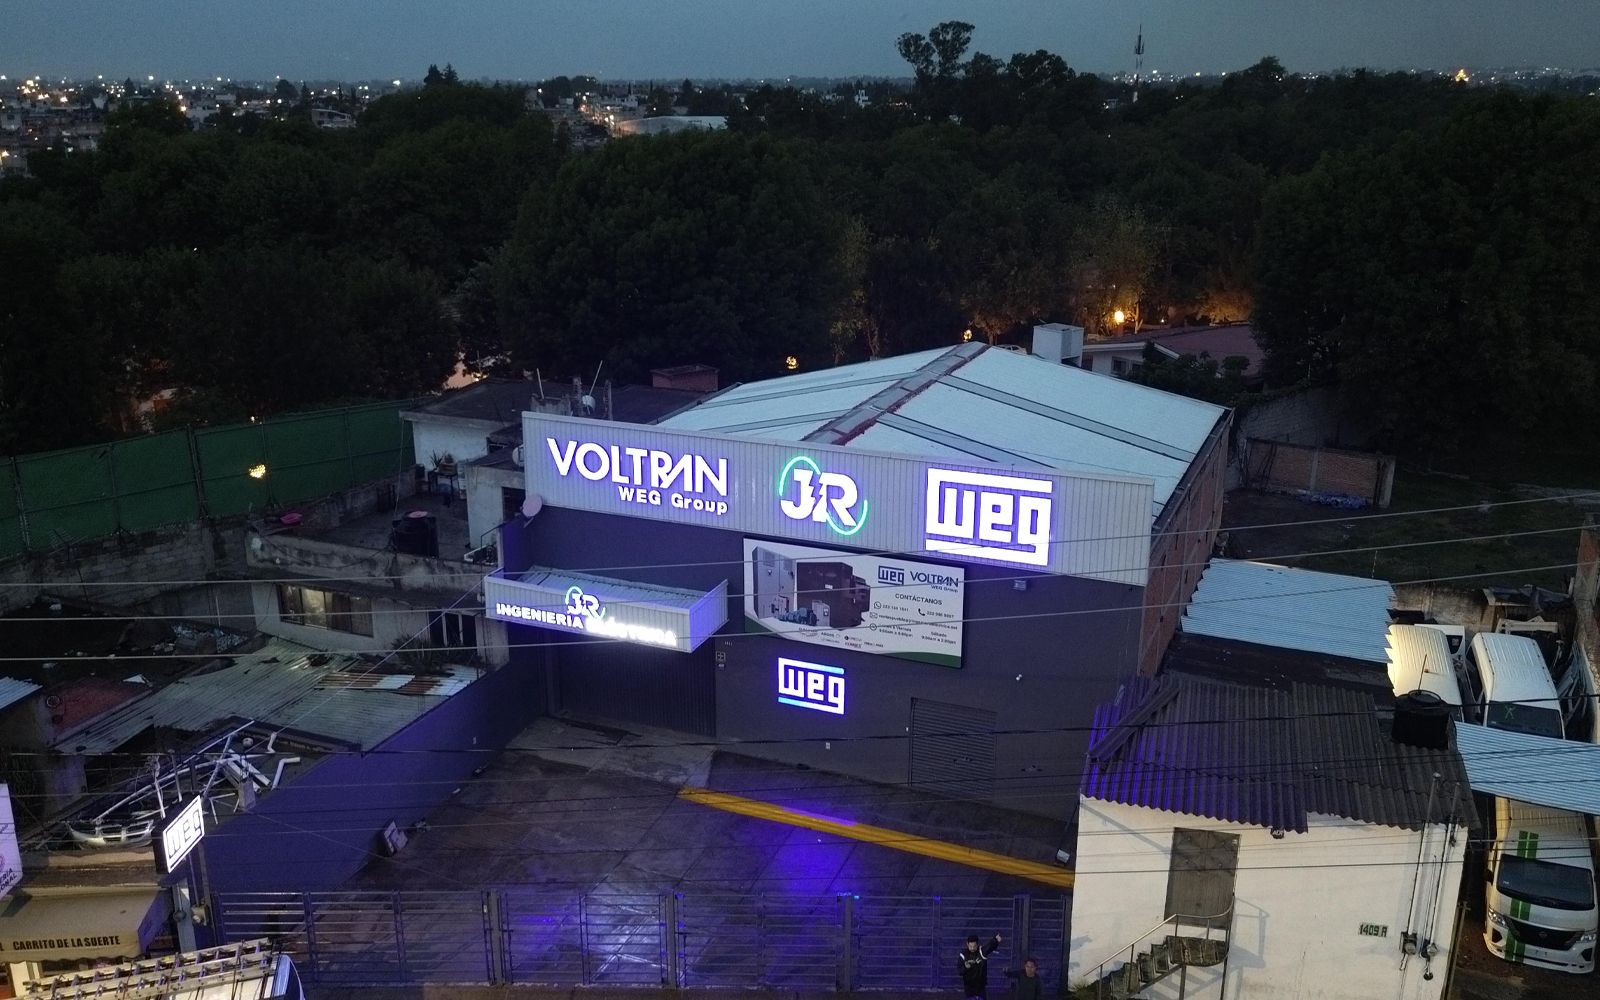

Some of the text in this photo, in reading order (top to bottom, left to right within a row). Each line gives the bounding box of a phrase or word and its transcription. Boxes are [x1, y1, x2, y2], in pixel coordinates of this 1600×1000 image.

[546, 437, 729, 497] VOLTRAN
[618, 485, 728, 516] WEG Group
[910, 571, 959, 588] VOLTRAN
[1359, 924, 1380, 936] 1409
[13, 939, 55, 951] CARRITO
[56, 938, 70, 949] DE
[70, 938, 84, 948] LA
[83, 935, 121, 947] SUERTE
